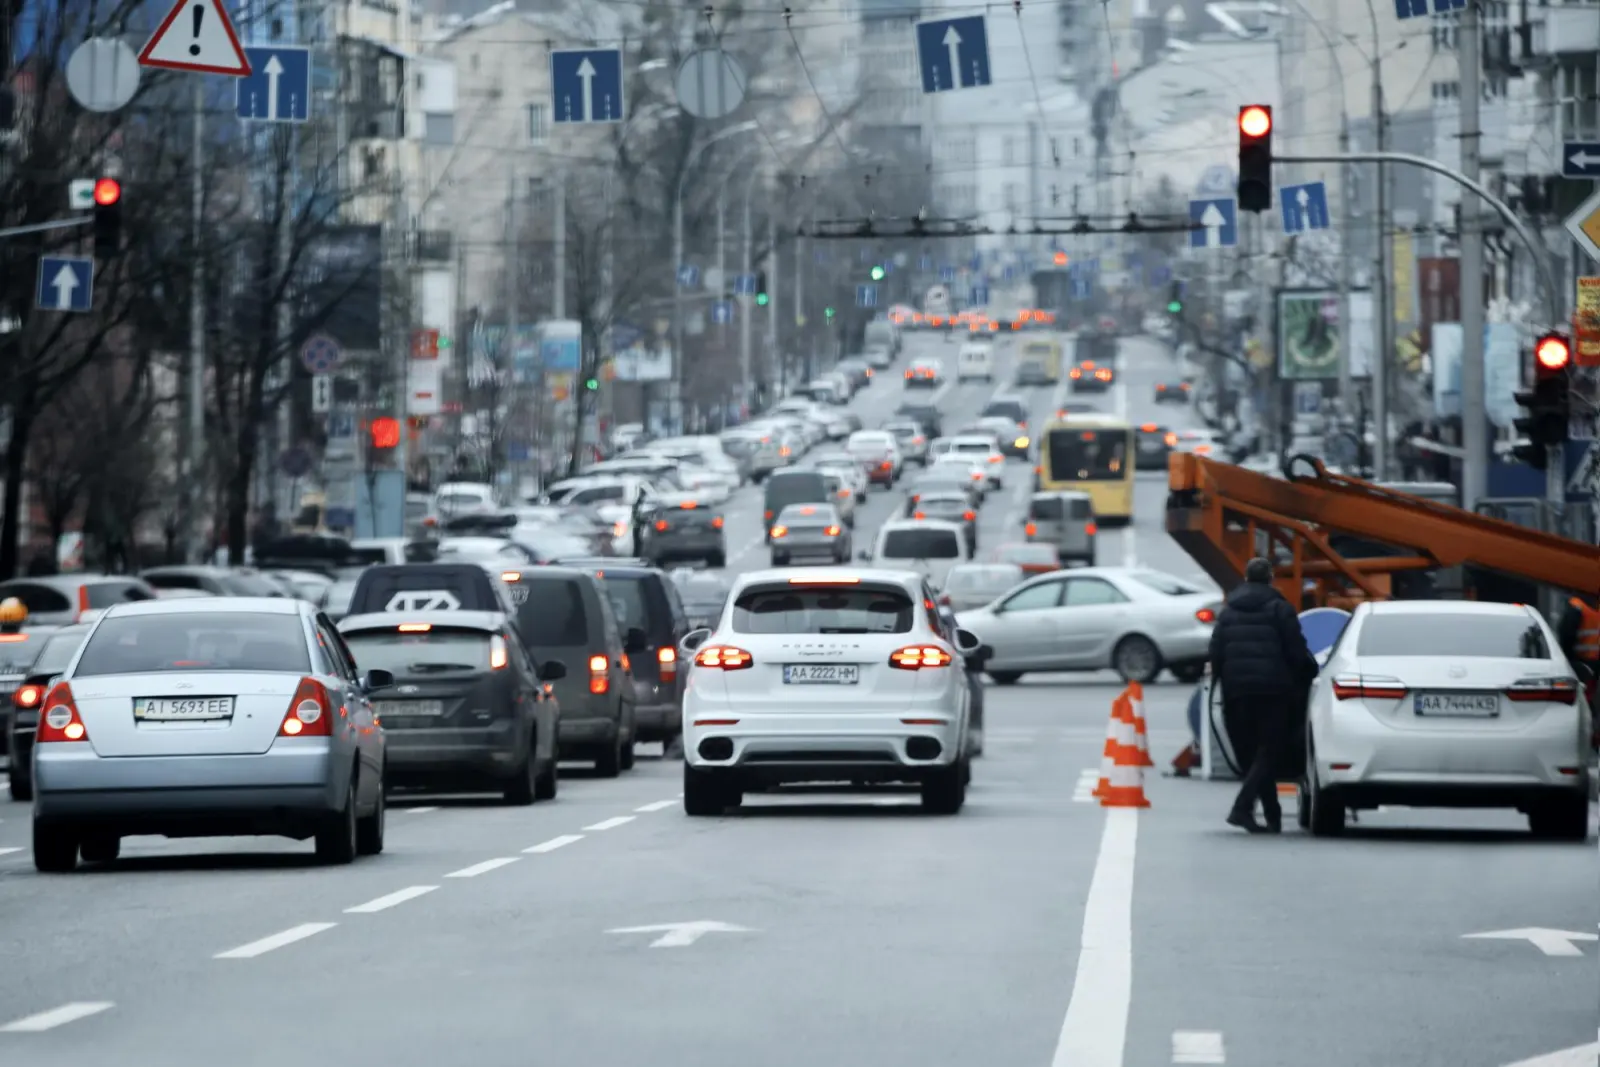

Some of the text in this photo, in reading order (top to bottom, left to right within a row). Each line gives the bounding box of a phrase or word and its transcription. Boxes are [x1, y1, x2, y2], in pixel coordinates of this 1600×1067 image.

[791, 667, 855, 678] AA 2222 HM
[146, 699, 228, 714] AI 5693 EE
[1422, 696, 1441, 709] AA
